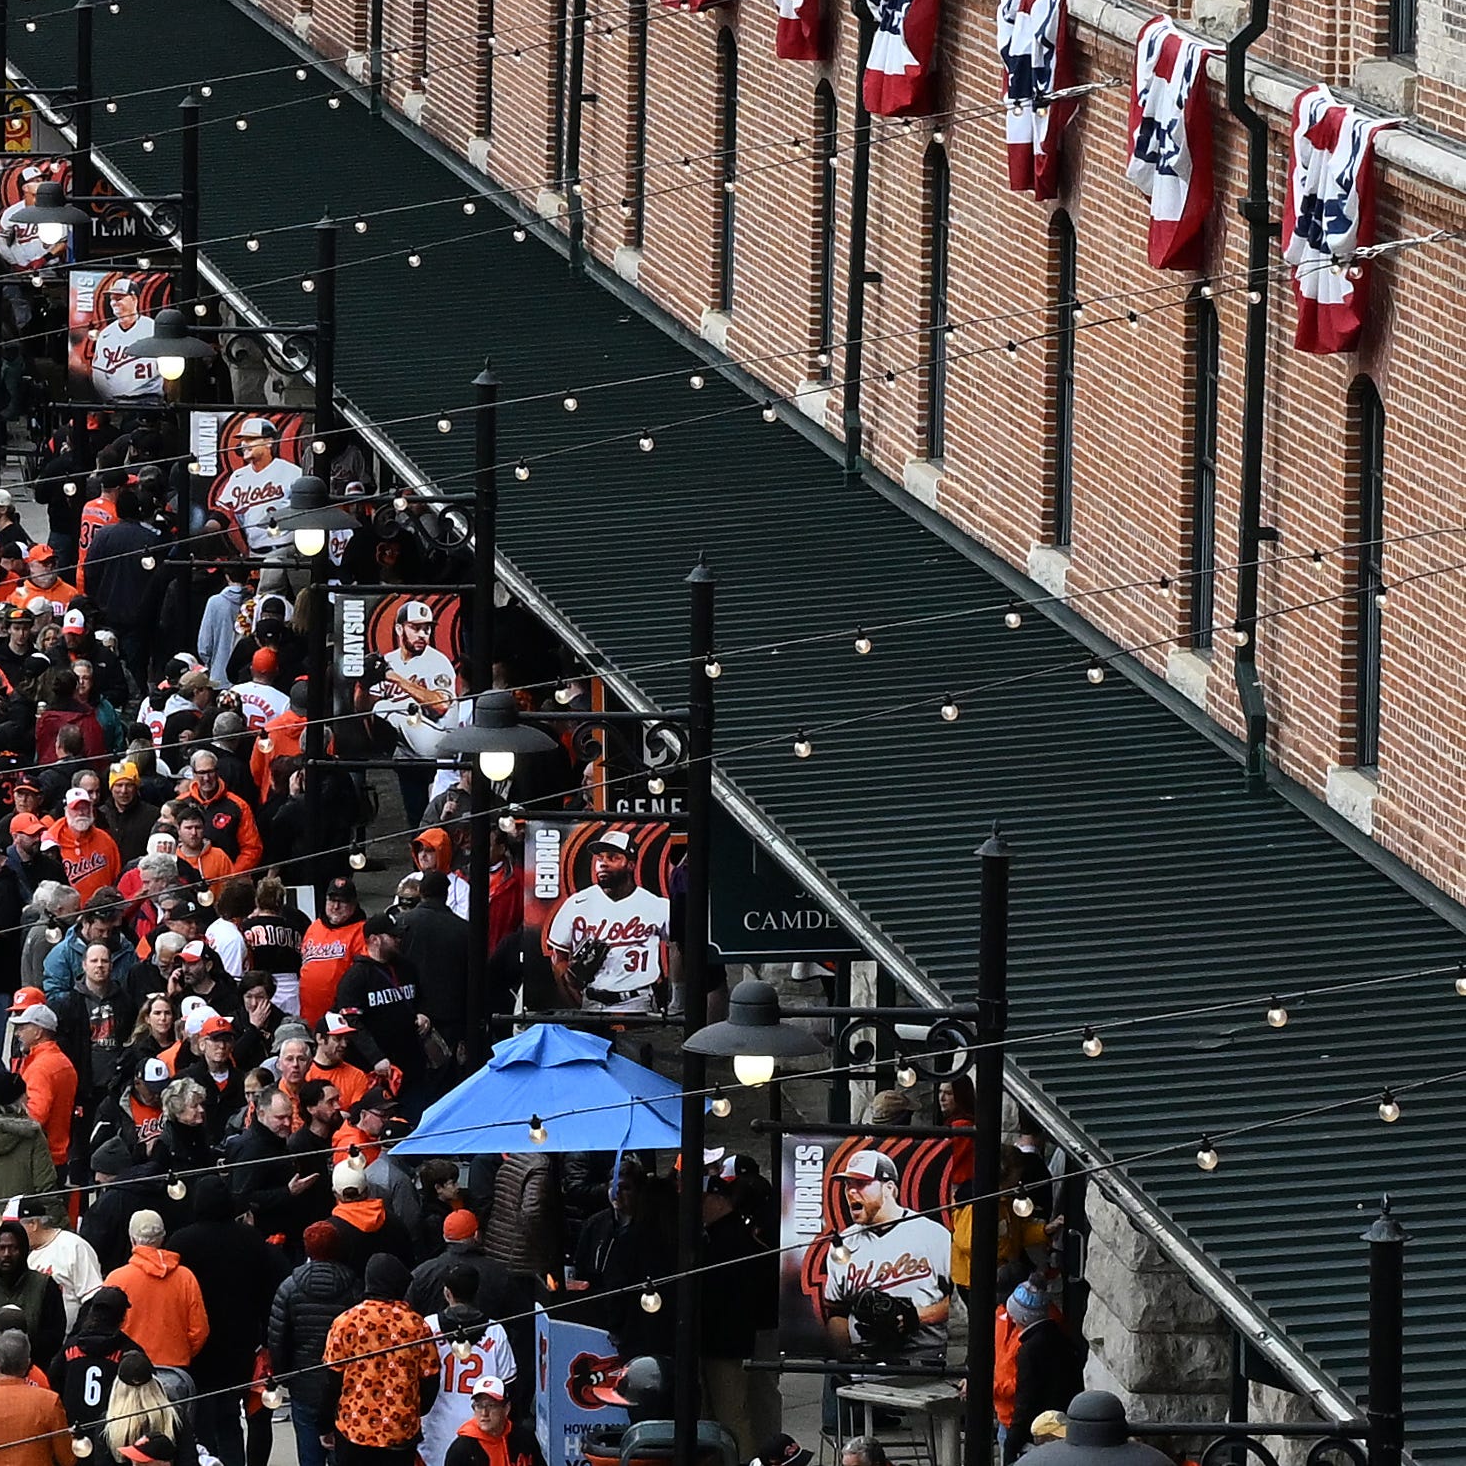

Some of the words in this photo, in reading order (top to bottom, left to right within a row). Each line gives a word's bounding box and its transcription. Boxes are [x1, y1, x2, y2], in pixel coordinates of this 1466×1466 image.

[77, 276, 94, 313] HAYS
[134, 363, 152, 380] 21
[199, 416, 217, 477] GUNNAR
[231, 483, 283, 513] Orioles
[343, 599, 365, 678] GRAYSON
[535, 828, 561, 900] CEDRIC
[572, 915, 661, 946] Orioles
[744, 910, 839, 932] CAMDE
[623, 949, 648, 973] 31
[794, 1144, 824, 1235] BURNES
[847, 1251, 931, 1291] Orioles
[83, 1365, 102, 1407] 6
[443, 1352, 485, 1394] 12
